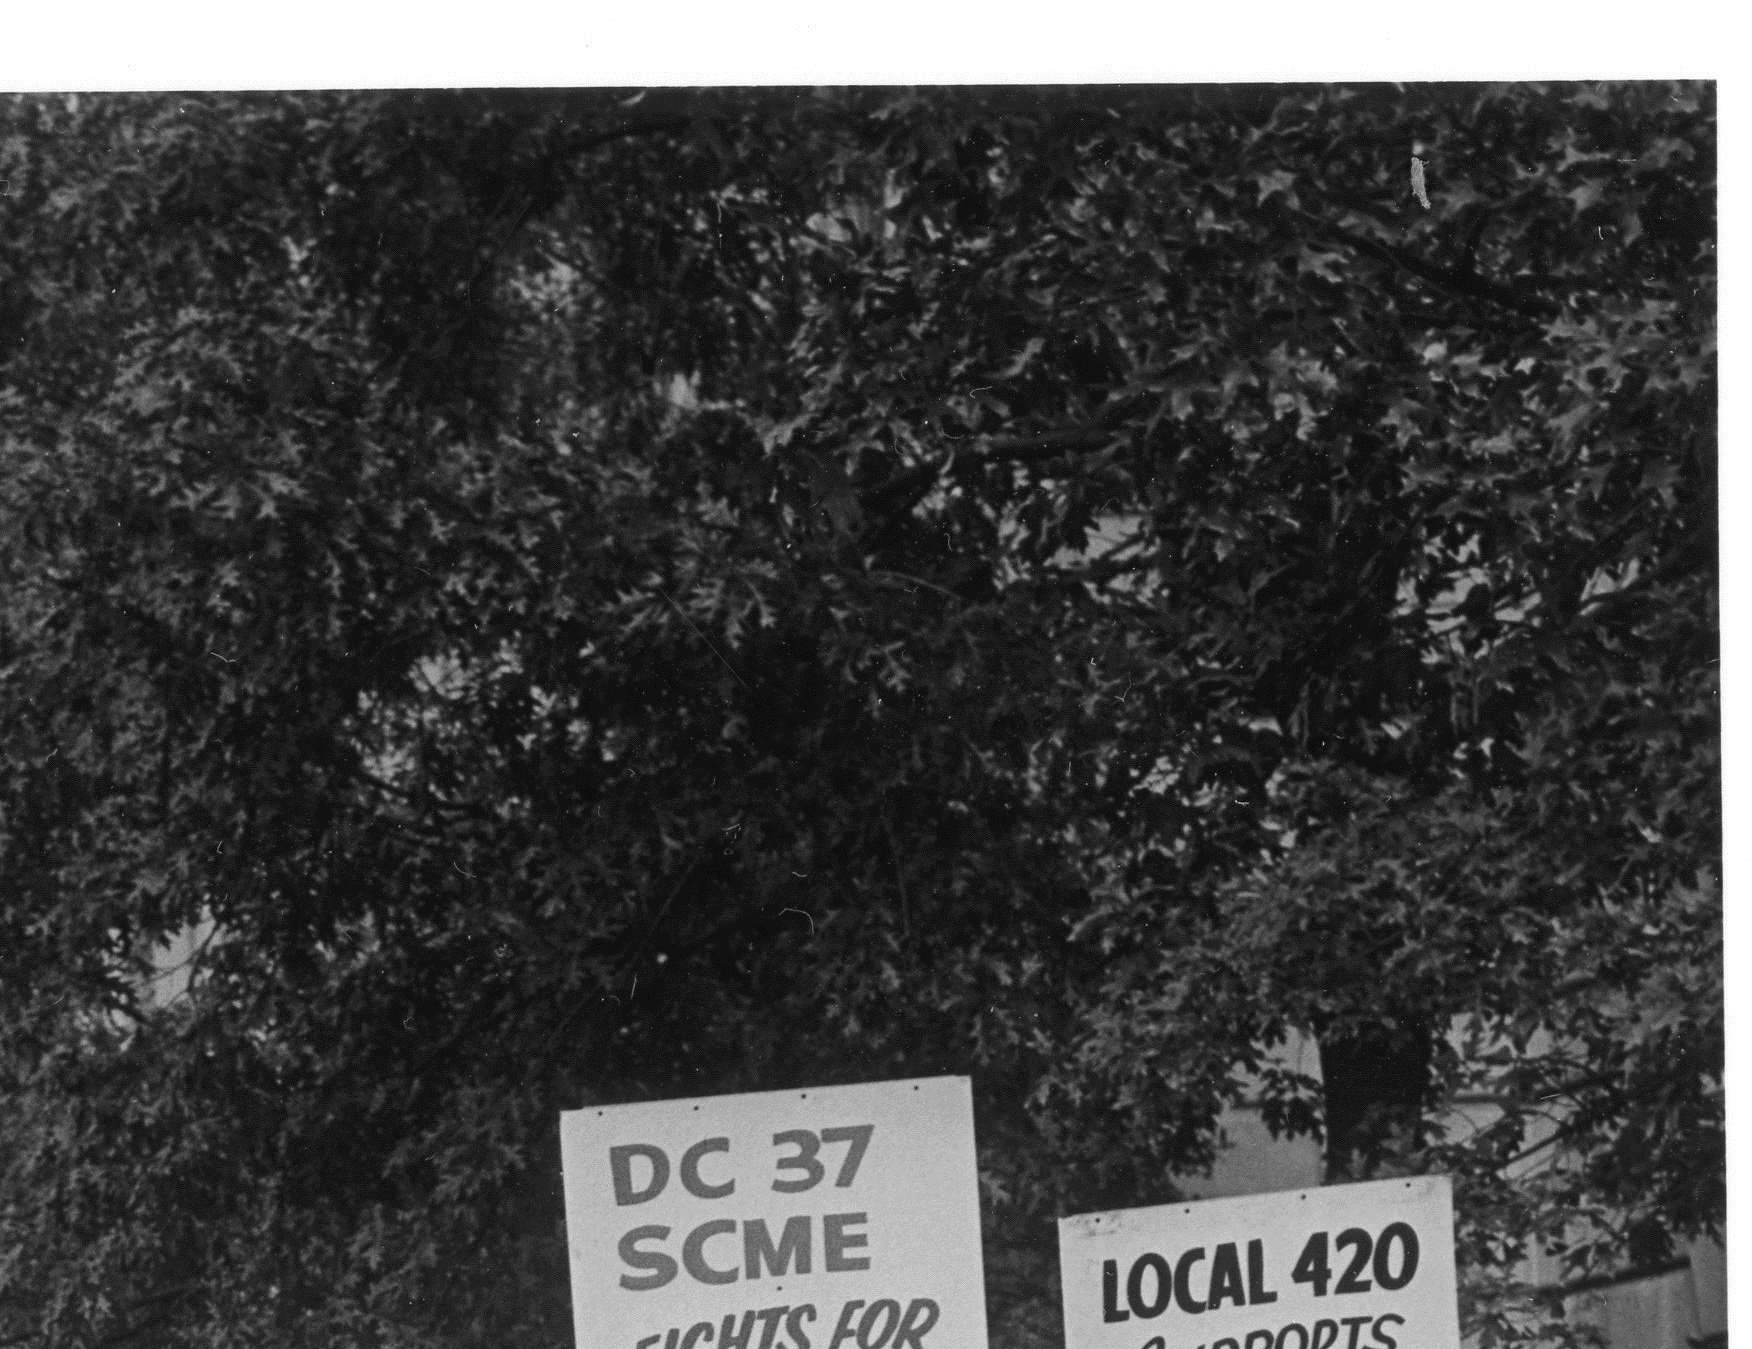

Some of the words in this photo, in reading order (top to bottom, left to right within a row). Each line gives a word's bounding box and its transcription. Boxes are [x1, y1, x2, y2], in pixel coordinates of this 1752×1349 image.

[609, 1137, 735, 1206] DC
[771, 1124, 875, 1193] 37
[617, 1212, 871, 1291] SCME
[1102, 1238, 1278, 1323] LOCAL
[1292, 1221, 1419, 1296] 420
